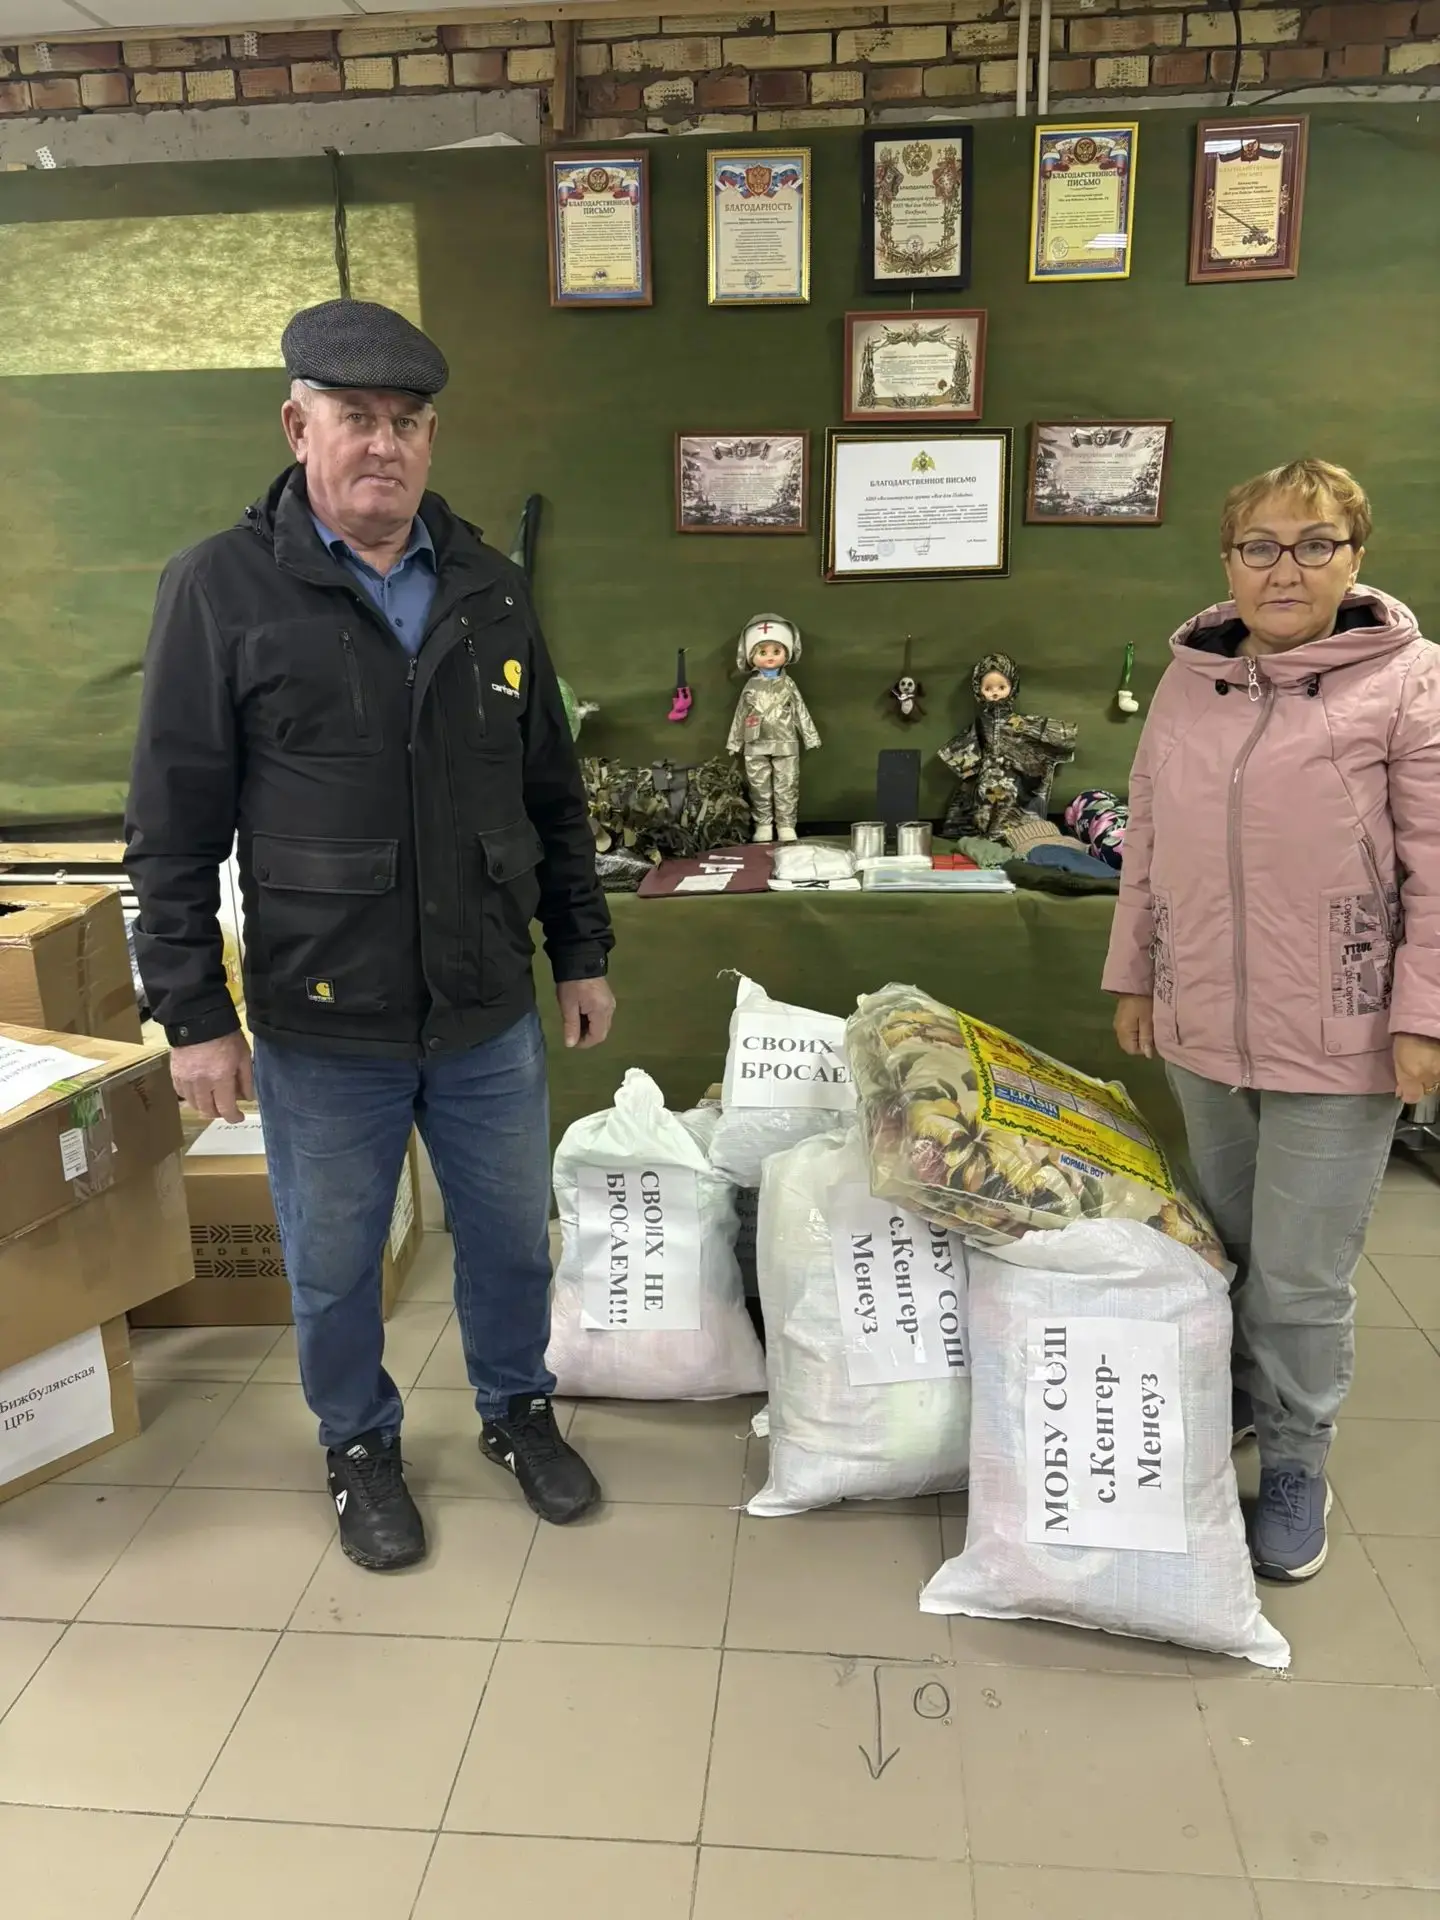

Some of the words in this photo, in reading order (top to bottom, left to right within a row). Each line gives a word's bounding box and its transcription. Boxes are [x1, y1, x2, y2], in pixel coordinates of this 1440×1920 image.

[725, 203, 793, 212] БЛАГОДАРНОСТЬ
[1067, 178, 1101, 187] ПИСЬМО
[869, 478, 944, 487] БЛАГОДАРСТВЕННОЕ
[945, 476, 977, 484] ПИСЬМО
[740, 1062, 853, 1083] БРОСАЕ
[742, 1036, 834, 1055] СВОИХ
[1060, 1154, 1089, 1173] NORMAL
[640, 1170, 664, 1259] СВОИХ
[606, 1173, 629, 1324] БРОСАЕМ!!!
[928, 1222, 955, 1281] ОБУ
[644, 1273, 664, 1311] НЕ
[851, 1231, 878, 1335] Менеуз
[889, 1216, 919, 1345] с.Кенгер-
[938, 1289, 965, 1368] СОШ
[0, 1365, 96, 1413] Бижбулякская
[1043, 1325, 1068, 1411] СОШ
[4, 1408, 35, 1431] ЦРБ
[1090, 1353, 1120, 1504] с.Кенгер-
[1137, 1372, 1166, 1490] Менеуз
[1044, 1420, 1069, 1533] МОБУ
